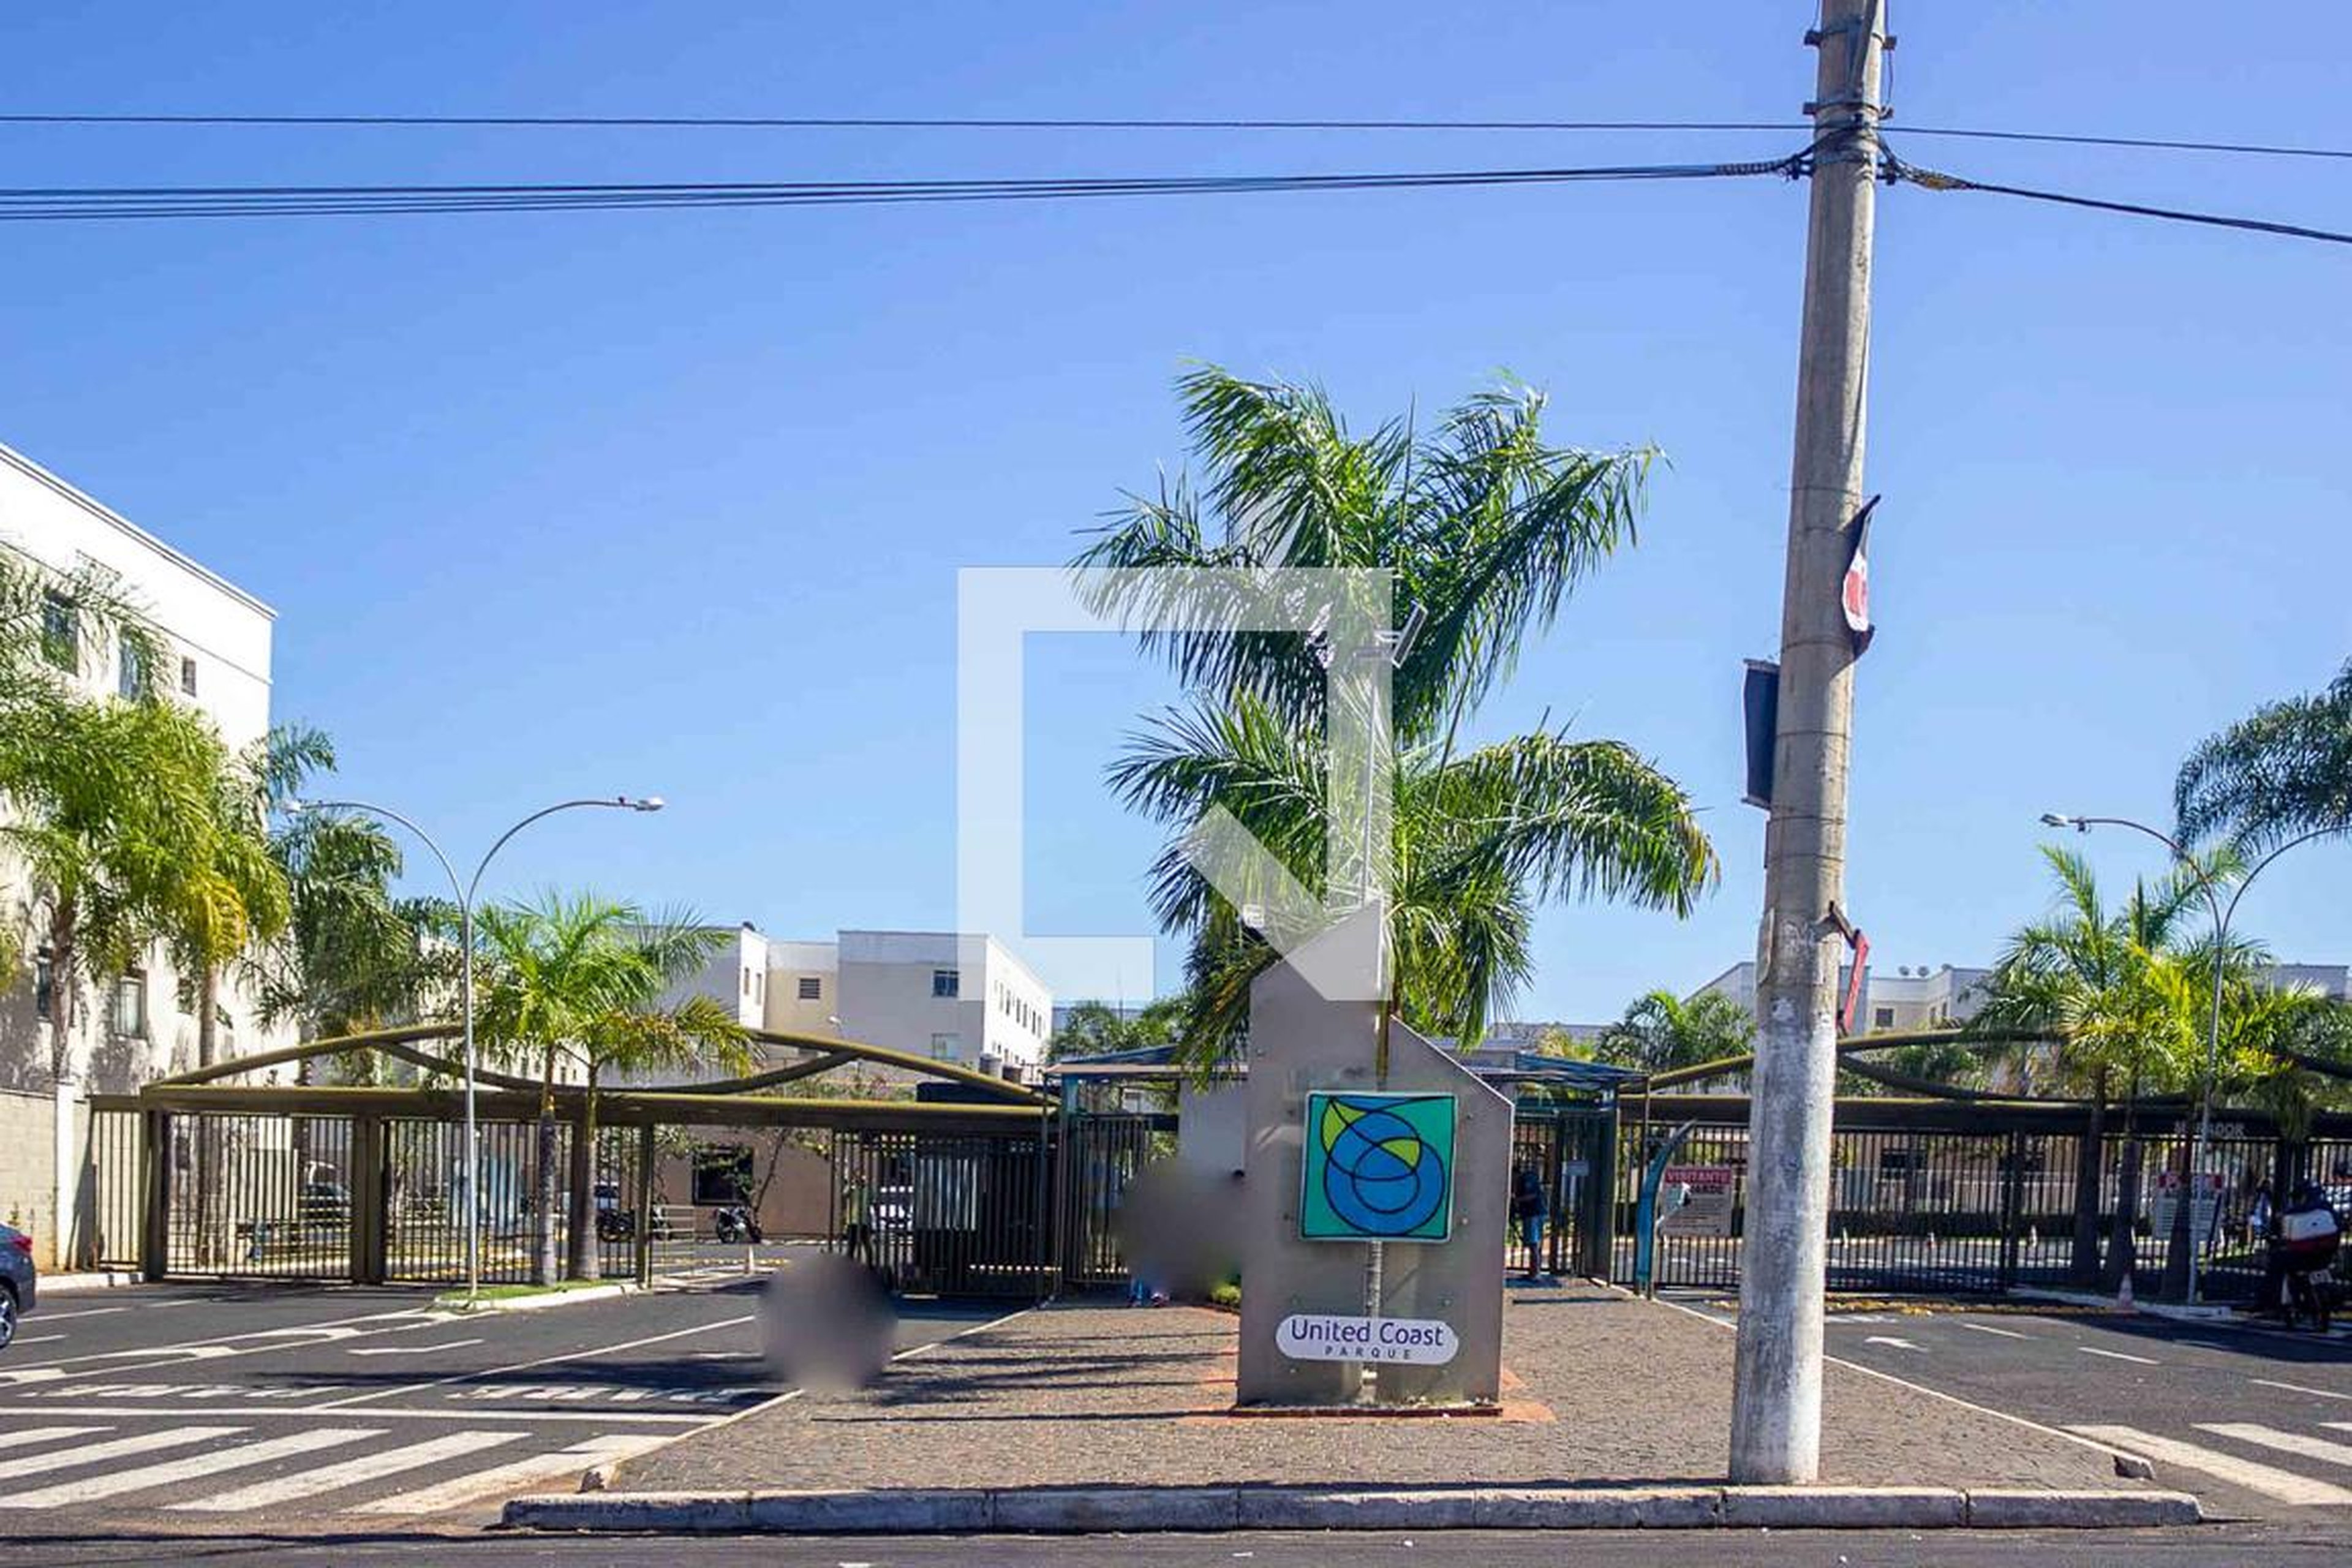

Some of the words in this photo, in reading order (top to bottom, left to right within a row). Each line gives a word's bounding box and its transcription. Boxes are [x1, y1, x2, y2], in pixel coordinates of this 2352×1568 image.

[1291, 1319, 1371, 1343] United
[1379, 1321, 1444, 1347] Coast
[1324, 1345, 1411, 1360] PARQUE
